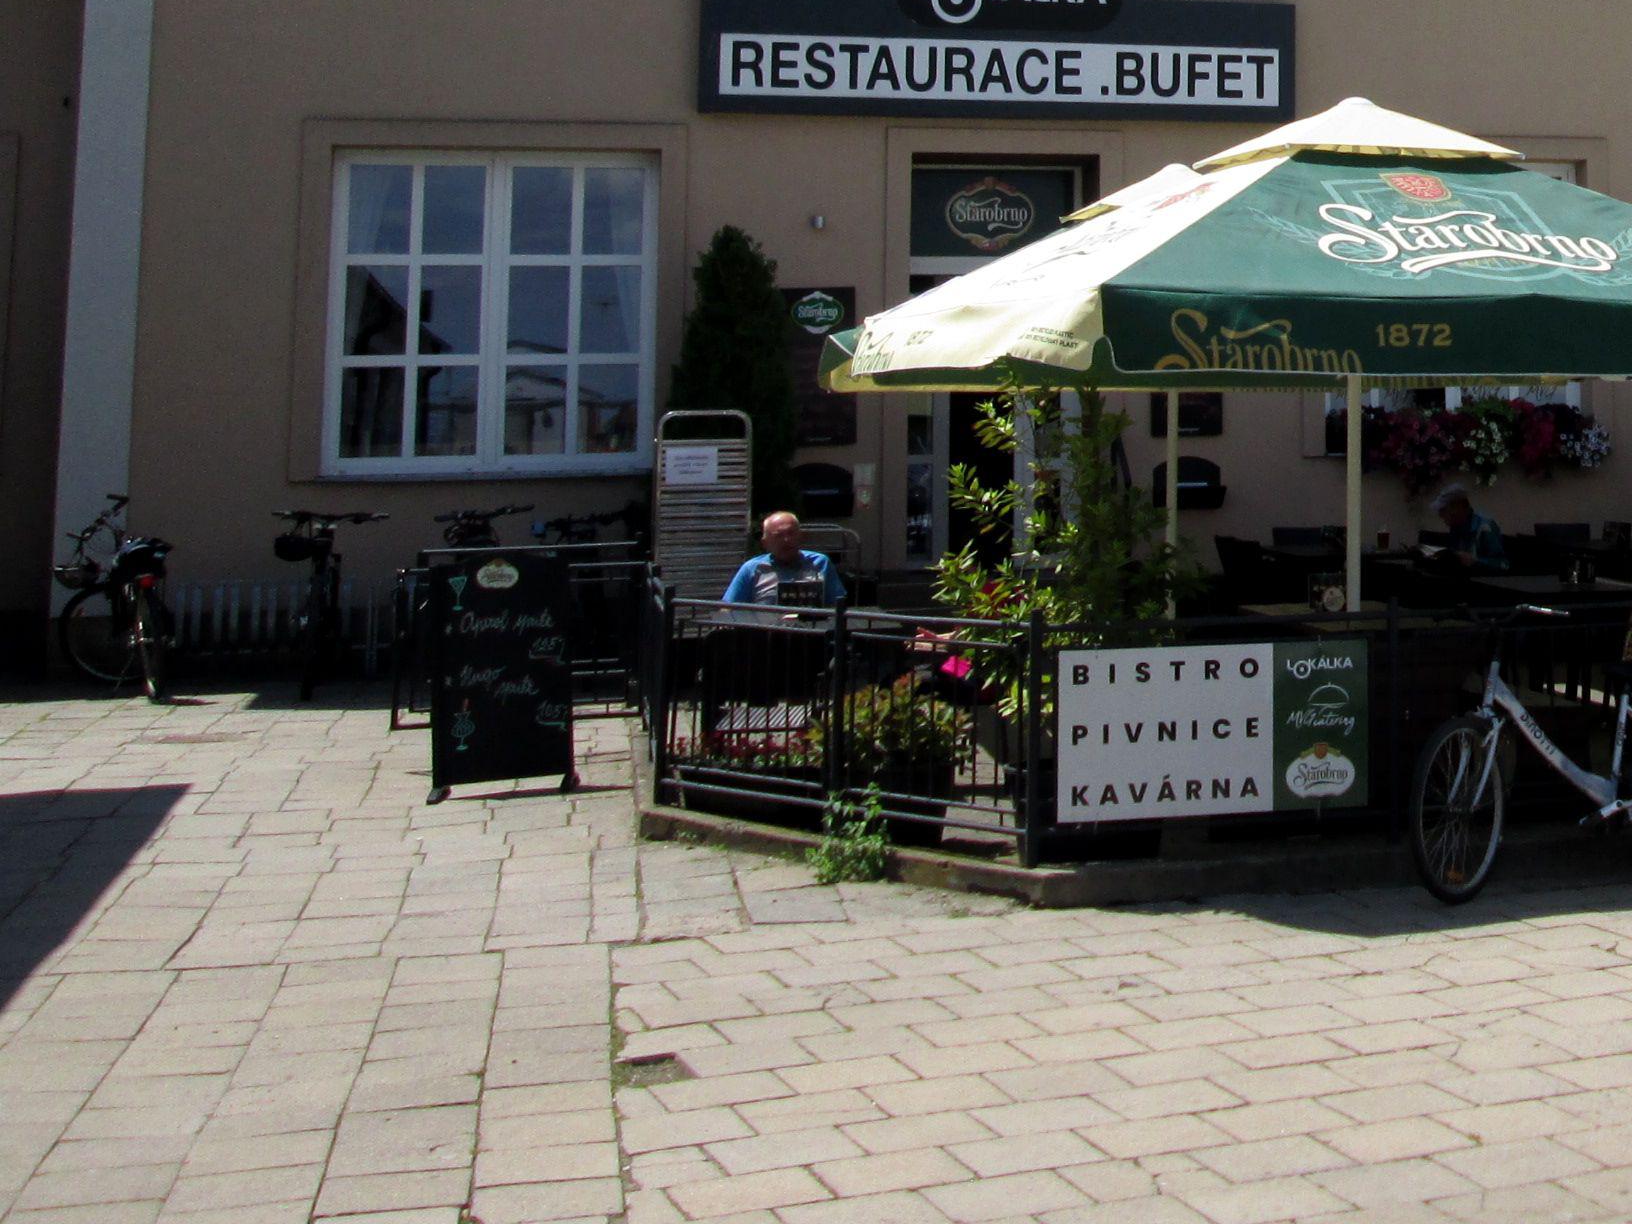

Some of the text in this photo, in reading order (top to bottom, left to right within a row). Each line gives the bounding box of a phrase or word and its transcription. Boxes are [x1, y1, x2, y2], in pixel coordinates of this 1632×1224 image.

[731, 40, 1083, 94] RESTAURACE
[954, 197, 1029, 232] Starobrno
[1317, 202, 1619, 273] Starobrno
[1154, 307, 1453, 374] Starobrno 1872
[1071, 657, 1260, 686] BISTRO
[1286, 655, 1354, 680] LOKÁLKA
[1071, 716, 1260, 746] PIVNICE
[1070, 774, 1260, 807] KAVÁRNA
[1293, 761, 1349, 790] Starobrno
